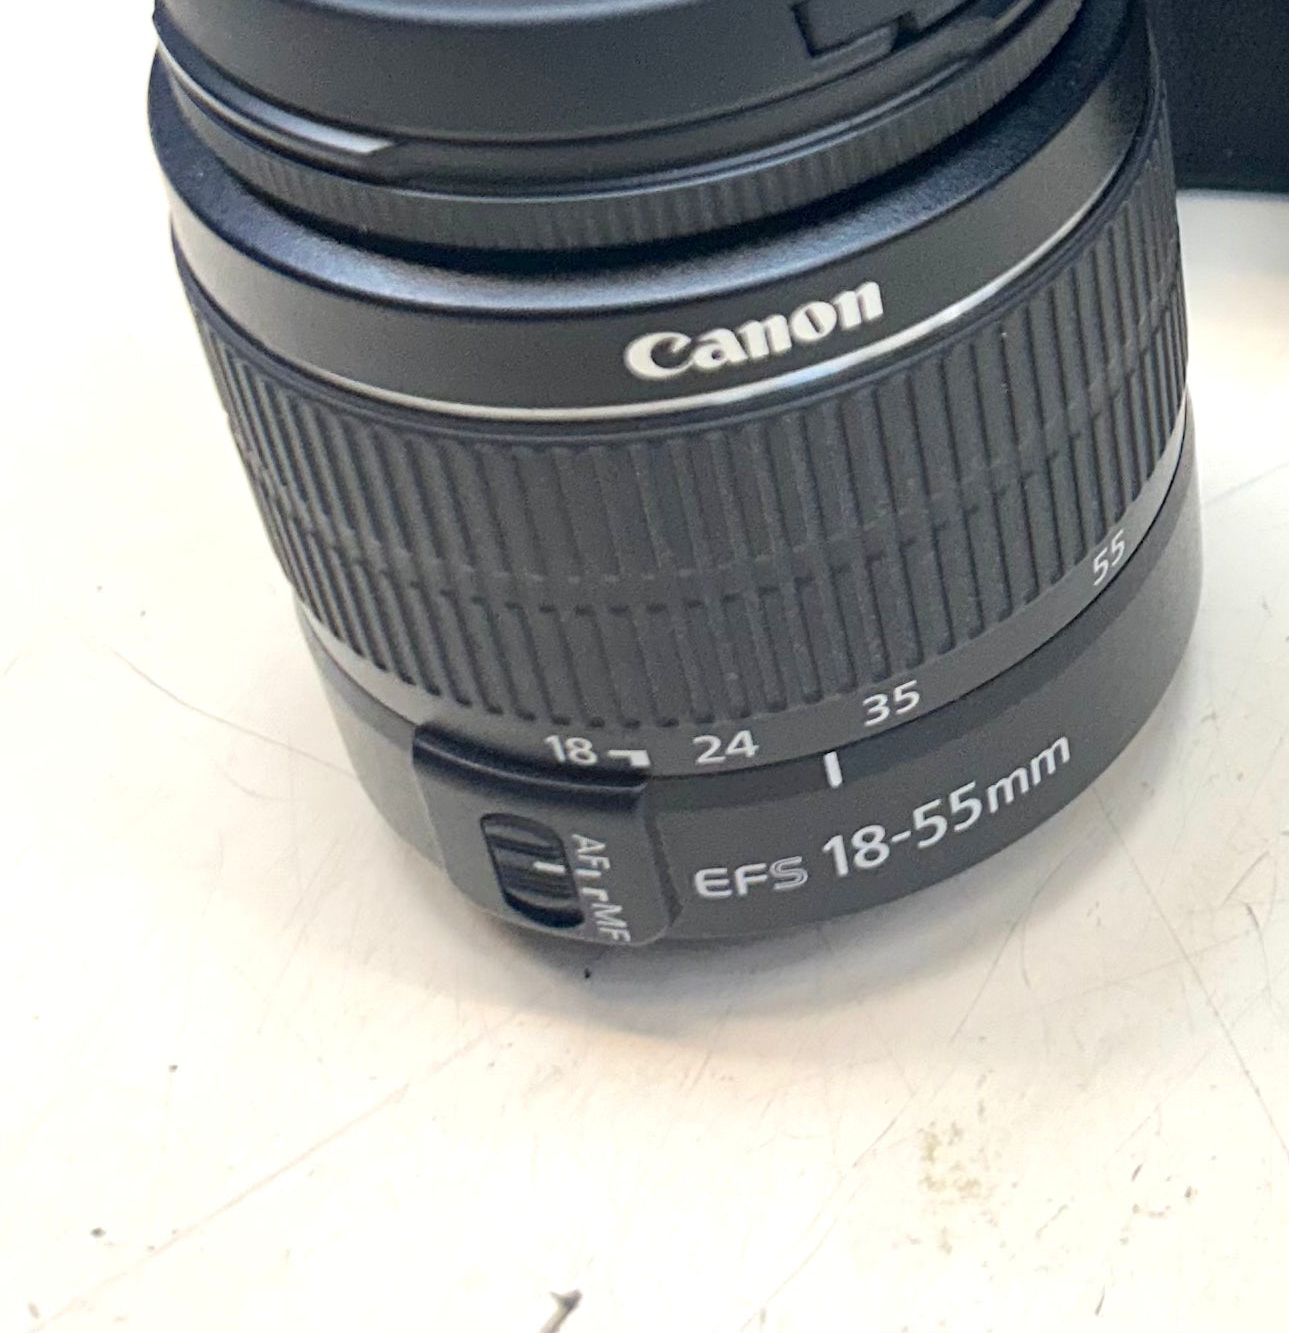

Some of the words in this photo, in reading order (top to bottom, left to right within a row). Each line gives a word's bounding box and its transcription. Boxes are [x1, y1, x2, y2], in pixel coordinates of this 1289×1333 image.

[624, 281, 883, 380] Canon
[545, 735, 598, 765] 18
[692, 730, 759, 764] 24
[862, 680, 920, 726] 35
[1093, 529, 1125, 586] 55
[572, 834, 610, 869] AF
[592, 903, 631, 941] MF
